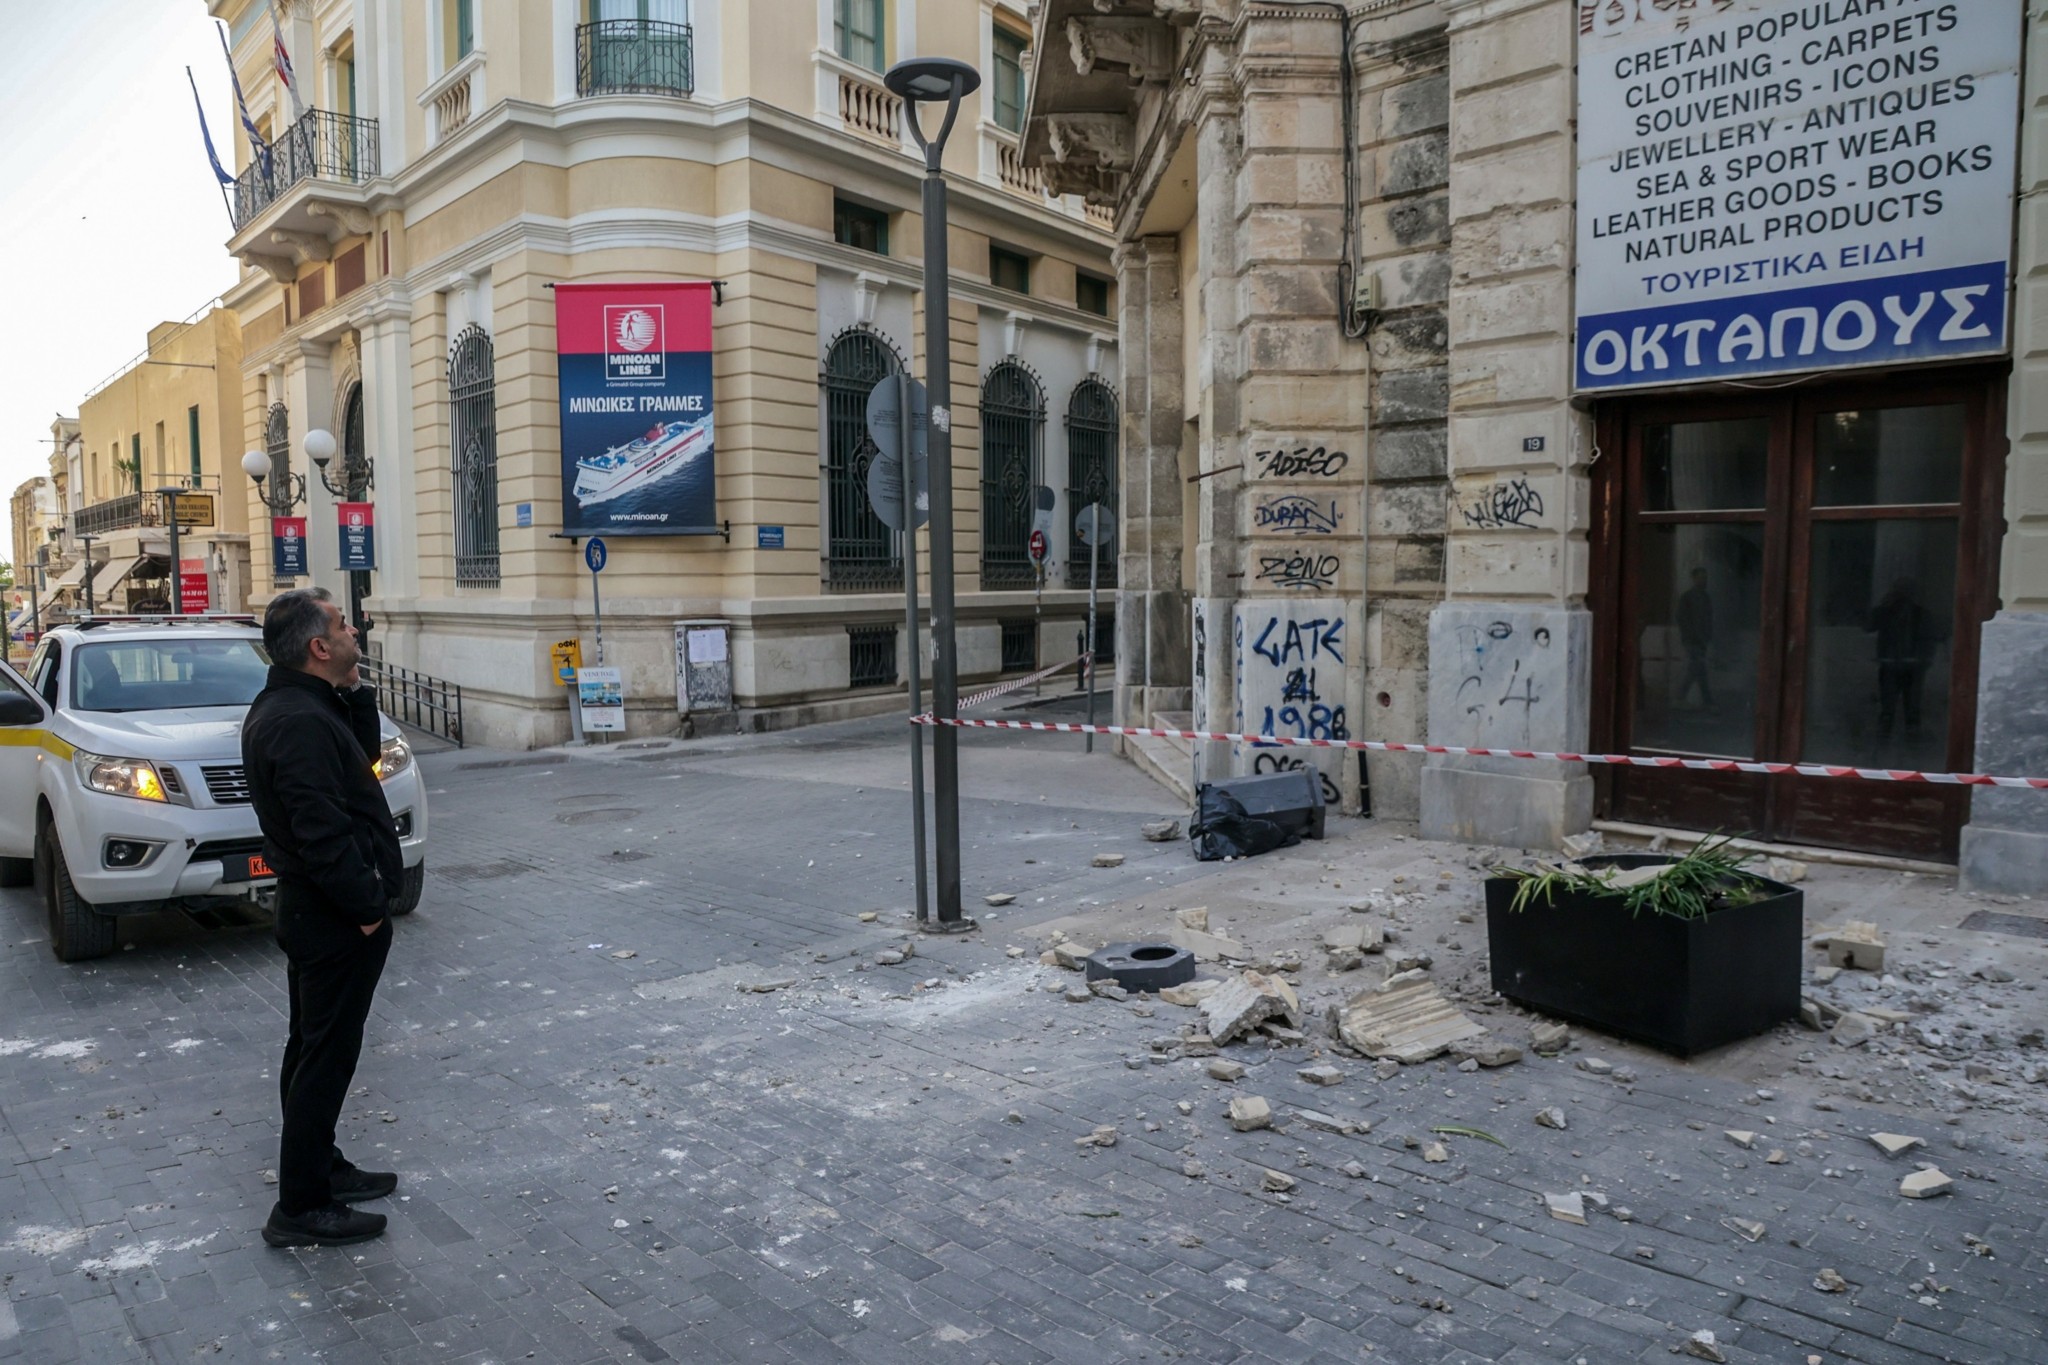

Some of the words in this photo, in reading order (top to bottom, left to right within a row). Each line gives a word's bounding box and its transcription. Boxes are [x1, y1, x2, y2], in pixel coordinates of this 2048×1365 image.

[1615, 31, 1725, 79] CRETAN
[1626, 53, 1772, 108] CLOTHING
[1801, 4, 1958, 66] CARPETS
[1609, 116, 1775, 173] JEWELLERY
[1802, 73, 1975, 133] ANTIQUES
[1635, 78, 1802, 136] SOUVENIRS
[1833, 45, 1940, 92] ICONS
[1592, 197, 1715, 238] LEATHER
[1725, 174, 1836, 214] GOODS
[1868, 145, 1992, 190] BOOKS
[1636, 170, 1689, 199] SEA
[1699, 165, 1716, 188] &
[1726, 141, 1829, 182] SPORT
[1838, 119, 1937, 160] WEAR
[1625, 223, 1754, 263] NATURAL
[1764, 190, 1943, 241] PRODUCTS
[1641, 251, 1828, 295] ΤΟΥΡΙΣΤΙΚΑ
[1839, 236, 1924, 268] ΕΙΔΗ
[609, 354, 660, 365] MINOAN
[1583, 284, 1991, 376] ΟΚΤΑΠΟΥΣ
[619, 365, 652, 375] LINES
[569, 397, 635, 413] ΜΙΝΩΙΚΕΣ
[640, 396, 703, 412] ΓΡΑΜΜΕΣ
[1528, 438, 1540, 450] 19
[610, 512, 668, 522] www.minoan.gr
